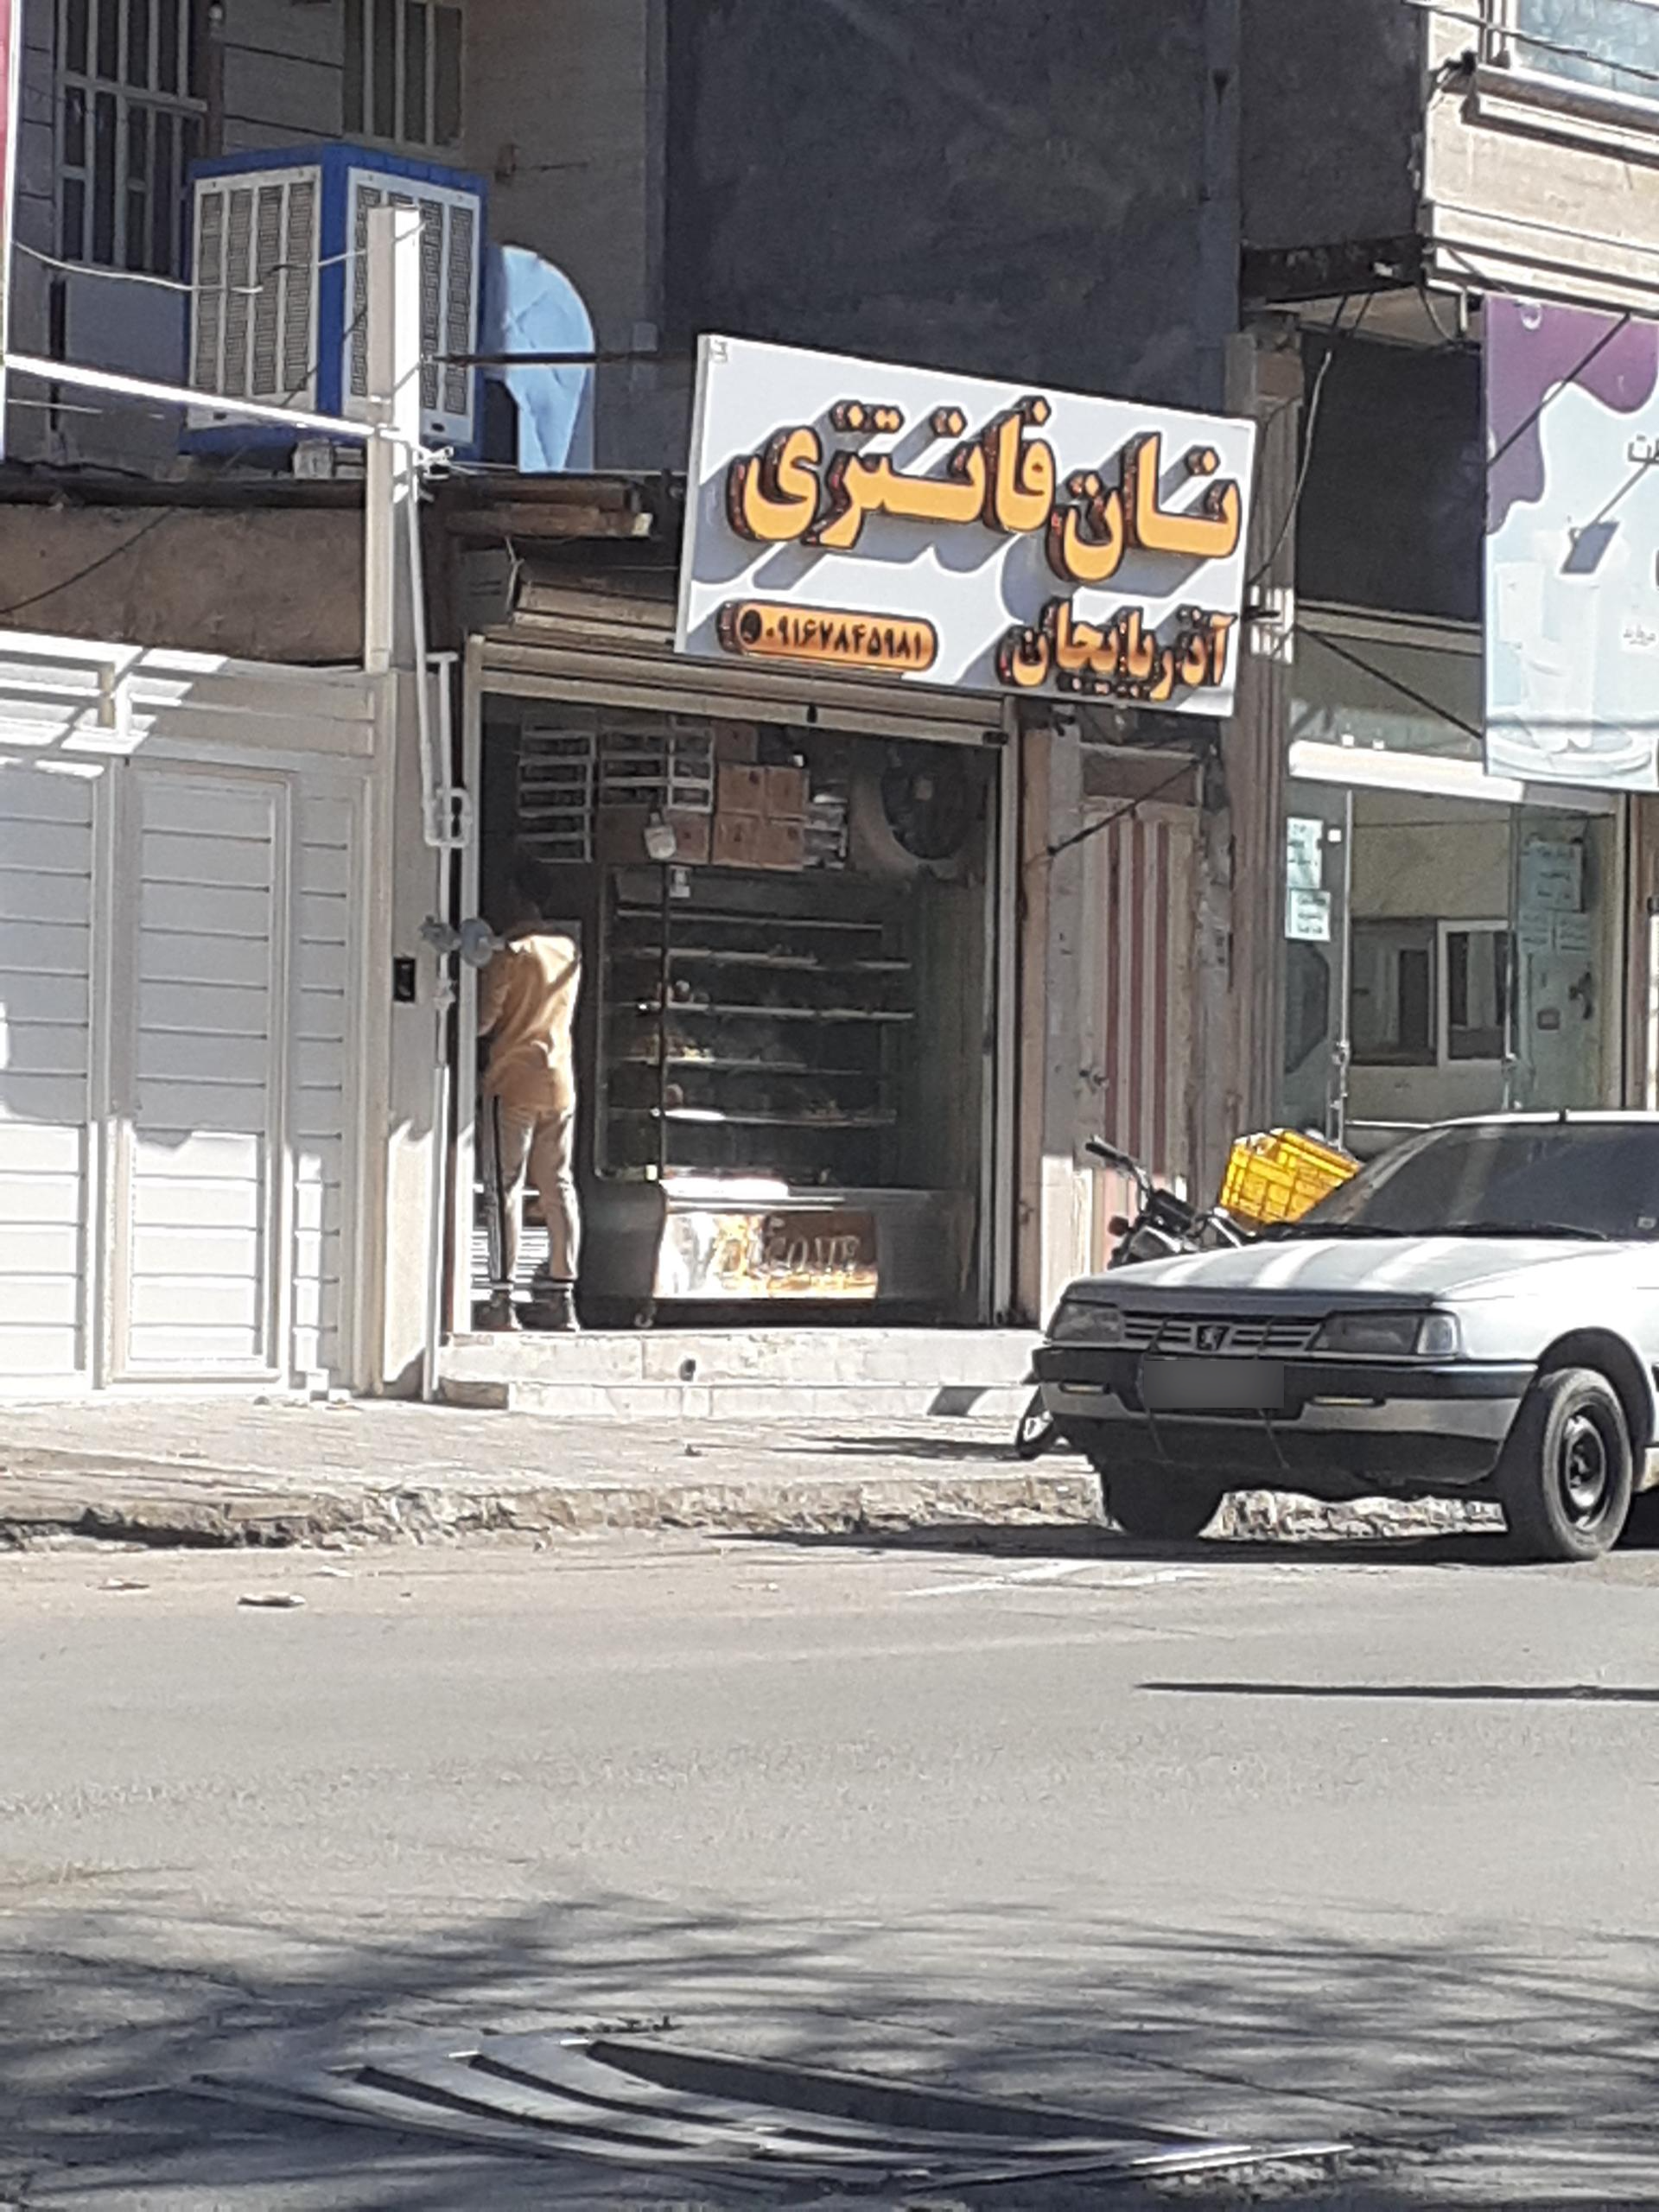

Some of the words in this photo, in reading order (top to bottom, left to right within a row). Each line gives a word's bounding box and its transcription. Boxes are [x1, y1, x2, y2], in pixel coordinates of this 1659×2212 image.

[730, 397, 1056, 548] فانتزی
[1046, 432, 1239, 582] نان
[999, 596, 1236, 702] آذربایجان
